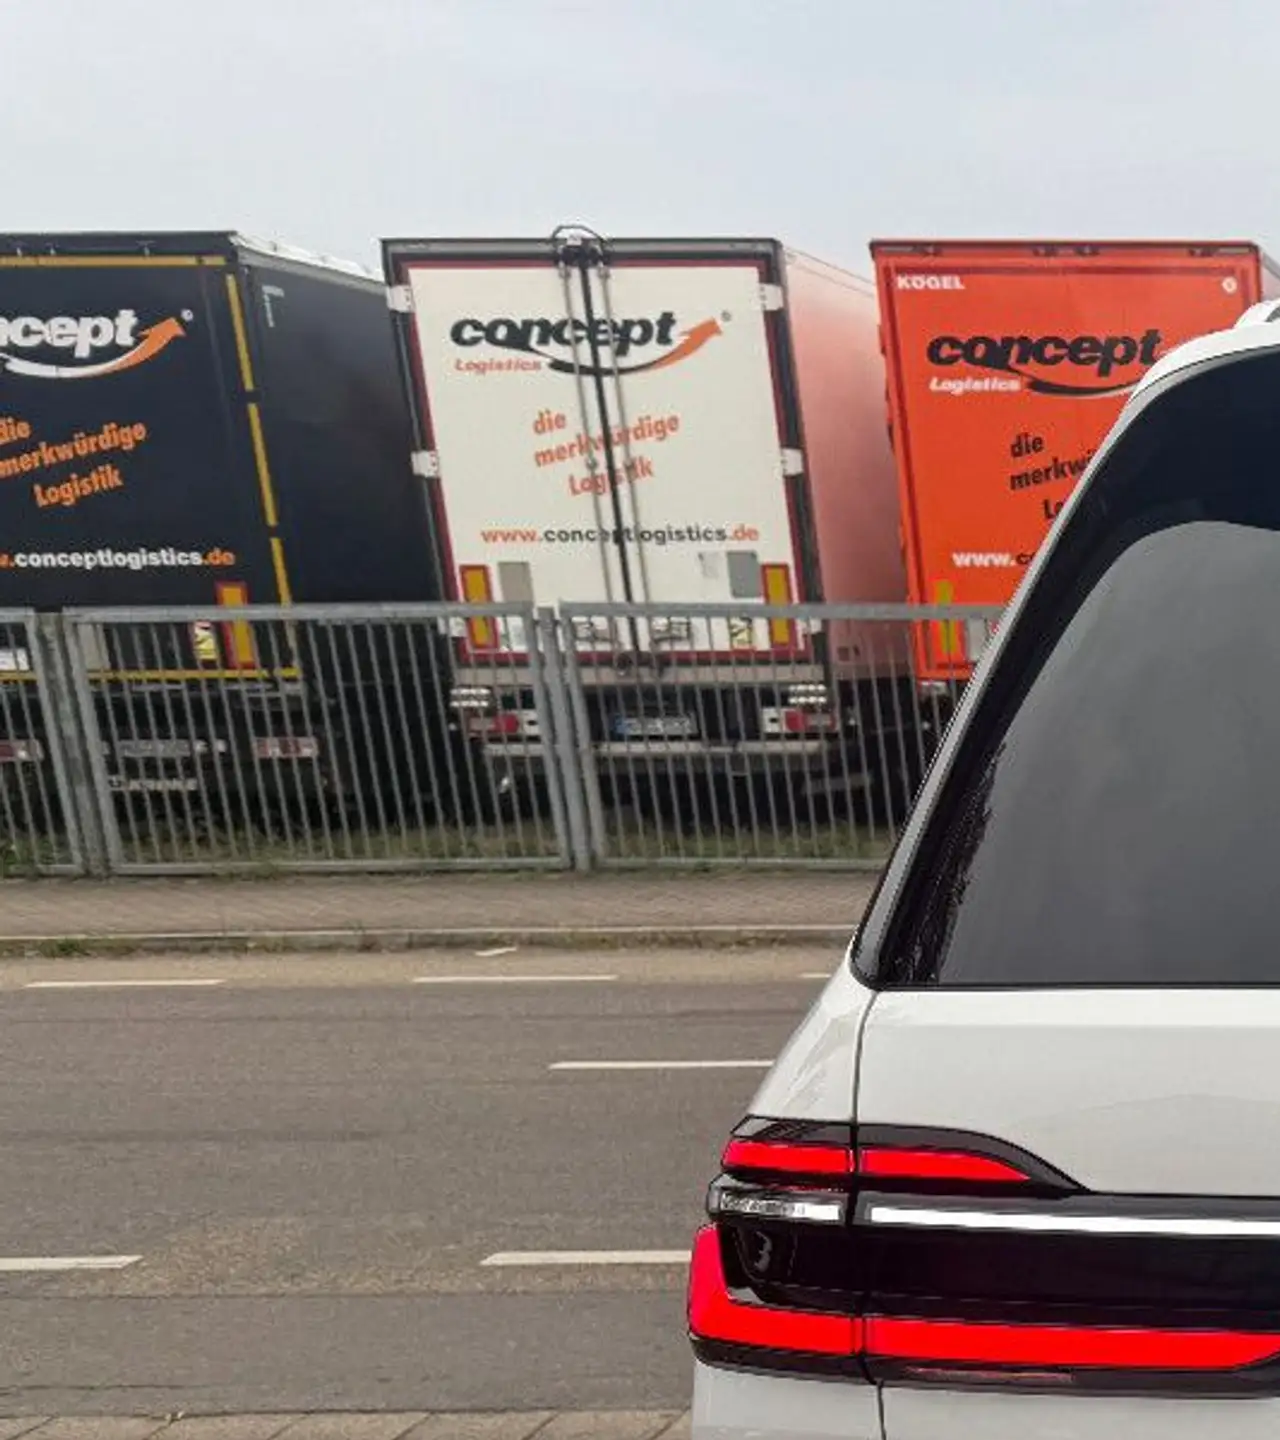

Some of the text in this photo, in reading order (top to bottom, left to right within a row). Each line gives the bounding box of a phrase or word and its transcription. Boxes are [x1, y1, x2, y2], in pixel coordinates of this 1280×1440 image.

[0, 309, 138, 358] cept
[450, 311, 676, 356] concept
[455, 358, 543, 375] Logistics
[926, 329, 1162, 378] concept
[929, 376, 1022, 397] Logistics
[532, 410, 567, 435] die
[1010, 432, 1044, 458] die
[33, 463, 125, 508] Logistik
[480, 524, 760, 545] www.concetlogistics.de
